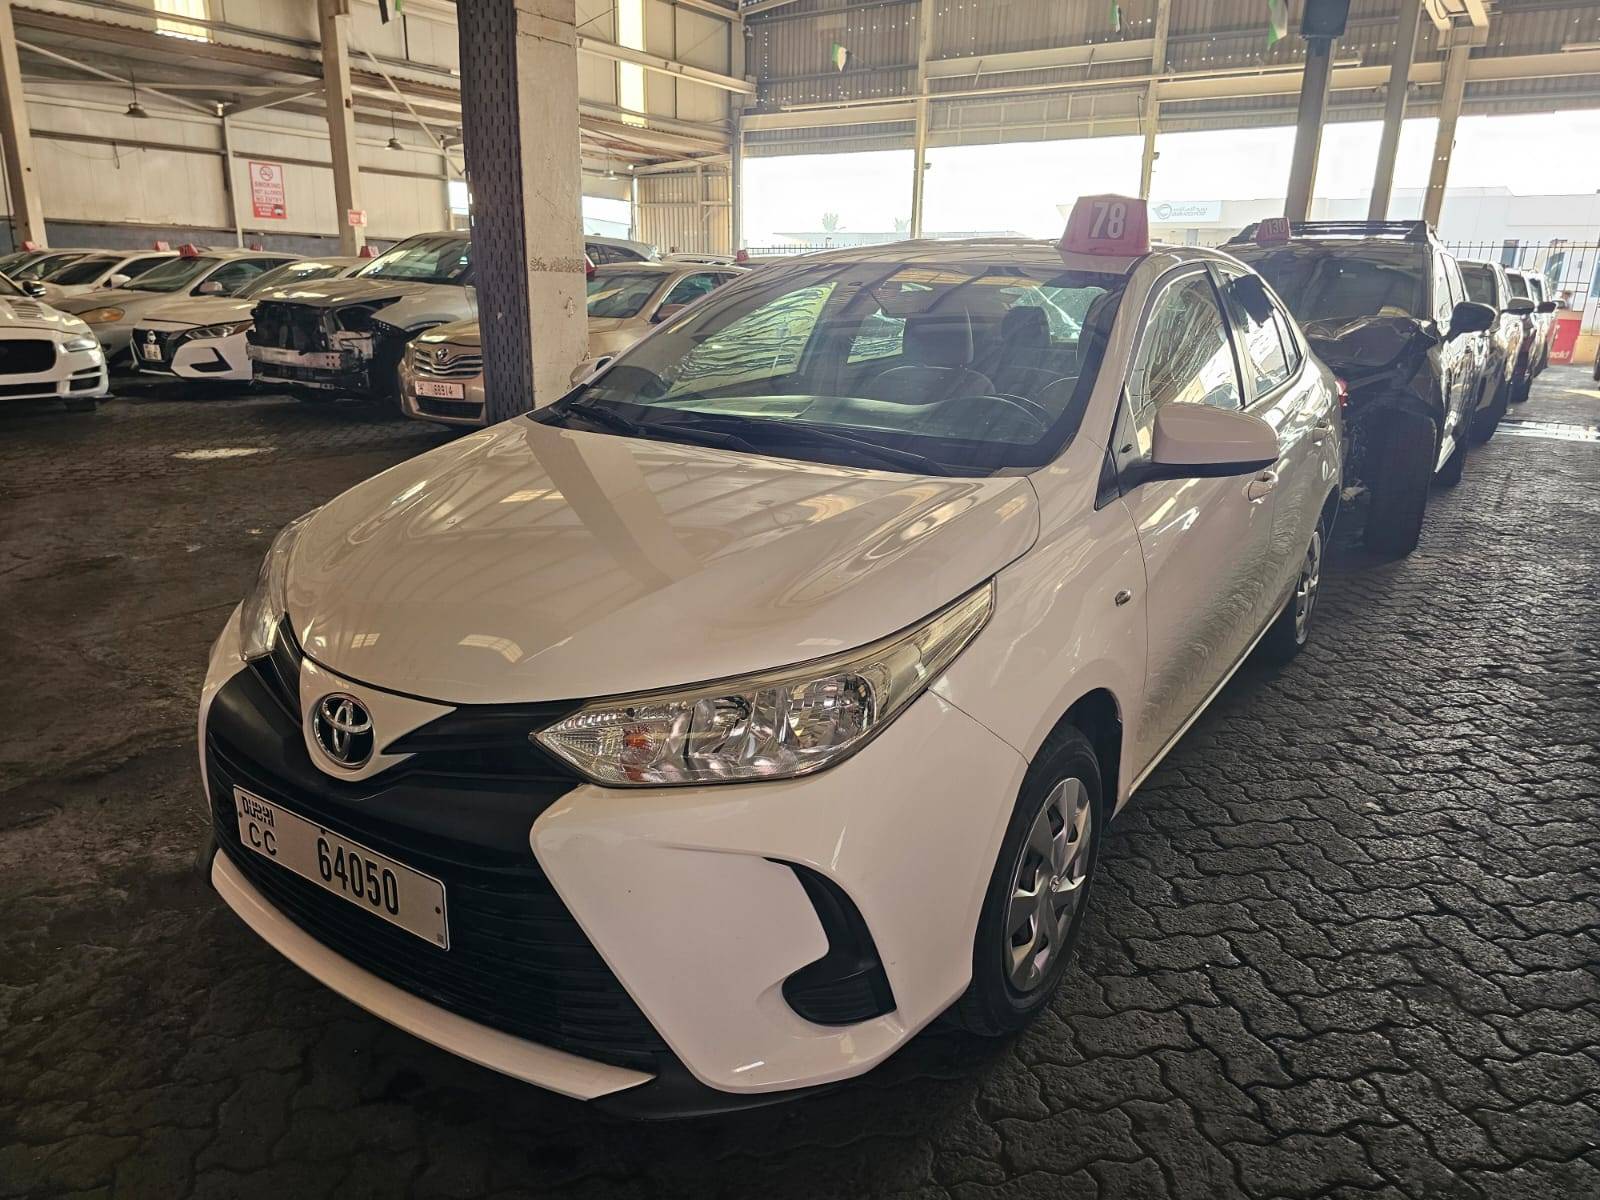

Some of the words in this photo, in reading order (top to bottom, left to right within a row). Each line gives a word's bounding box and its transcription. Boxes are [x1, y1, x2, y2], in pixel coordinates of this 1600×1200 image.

[1091, 201, 1126, 239] 78
[249, 822, 277, 856] CC
[317, 837, 399, 916] 64050
